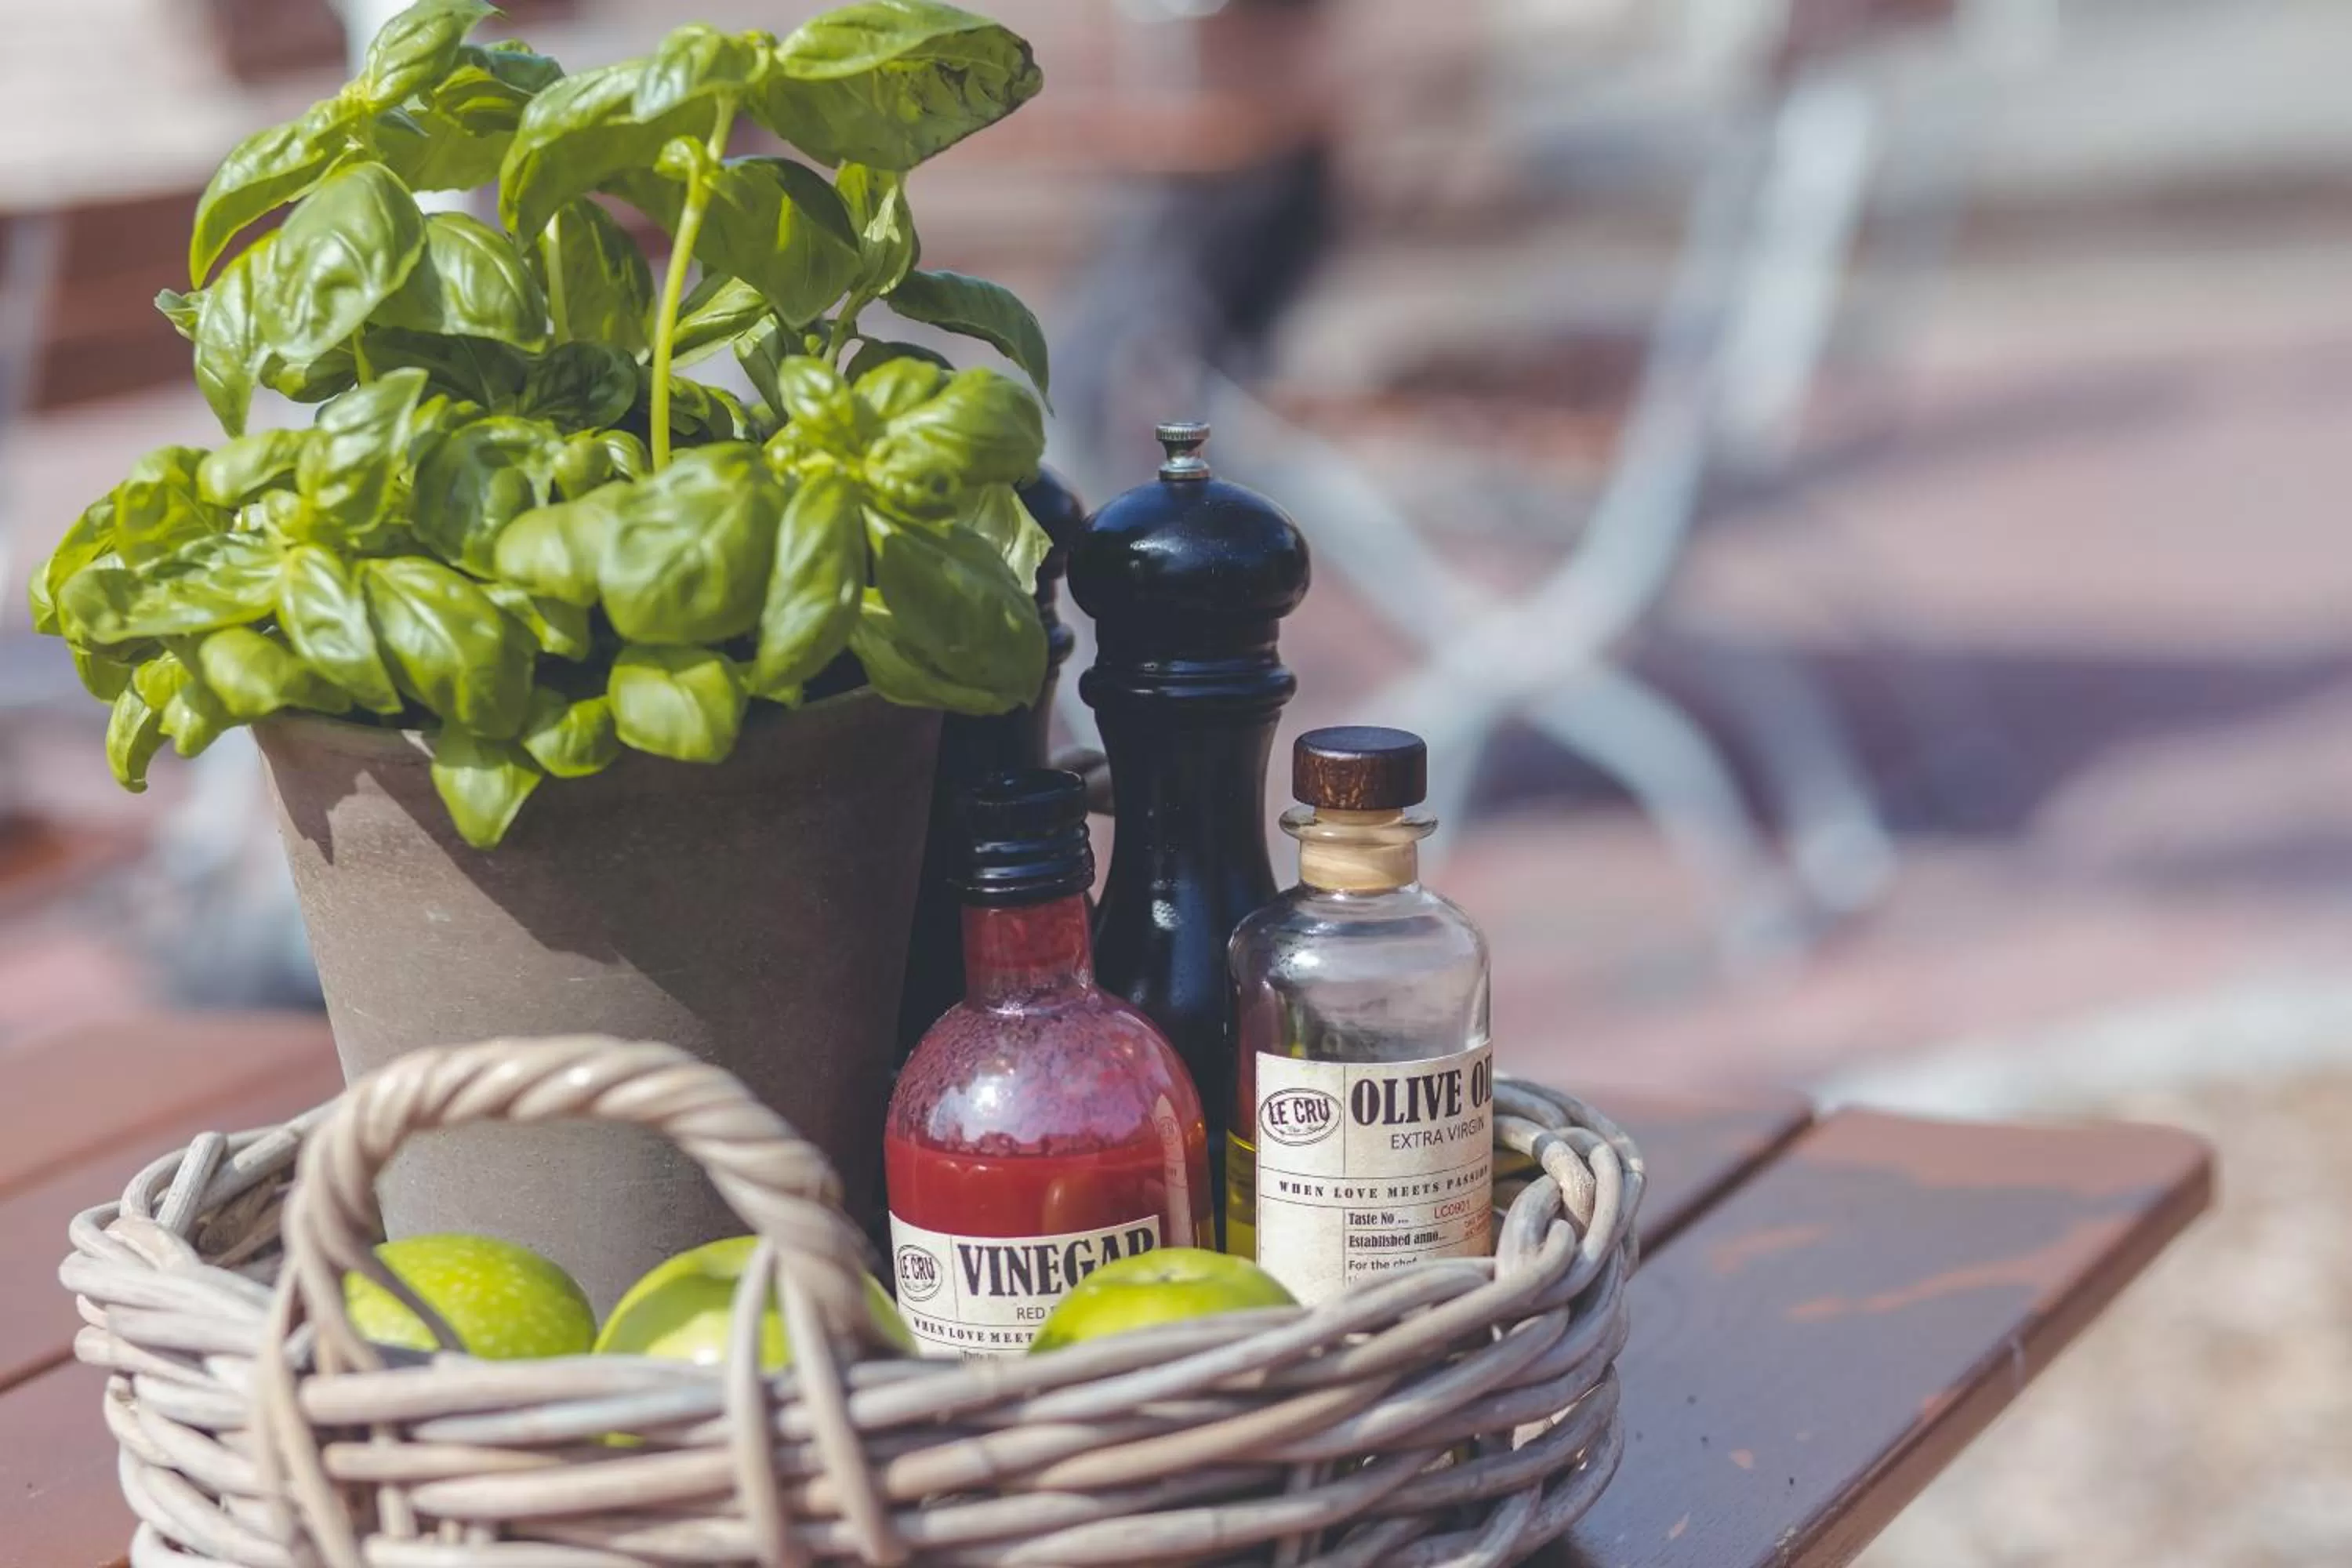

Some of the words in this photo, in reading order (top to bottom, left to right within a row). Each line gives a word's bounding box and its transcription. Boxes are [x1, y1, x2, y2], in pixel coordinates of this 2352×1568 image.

[1351, 1069, 1462, 1127] OLIVE
[1472, 1053, 1492, 1109] OI
[1268, 1101, 1289, 1125] LE
[1294, 1098, 1330, 1123] CRU
[1390, 1130, 1443, 1149] EXTRA
[1446, 1116, 1484, 1141] VIRGIN
[1279, 1180, 1324, 1197] WHEN
[1334, 1187, 1377, 1199] LOVE
[1387, 1181, 1439, 1198] MEETS
[1348, 1212, 1377, 1225] Taste
[1381, 1212, 1395, 1225] No
[1348, 1233, 1410, 1247] Established
[899, 1255, 909, 1279] LE
[911, 1256, 935, 1280] CRU
[1348, 1259, 1367, 1271] For
[1371, 1258, 1390, 1270] the
[1017, 1307, 1046, 1320] RED
[913, 1316, 945, 1336] WHEN
[949, 1325, 985, 1342] LOVE
